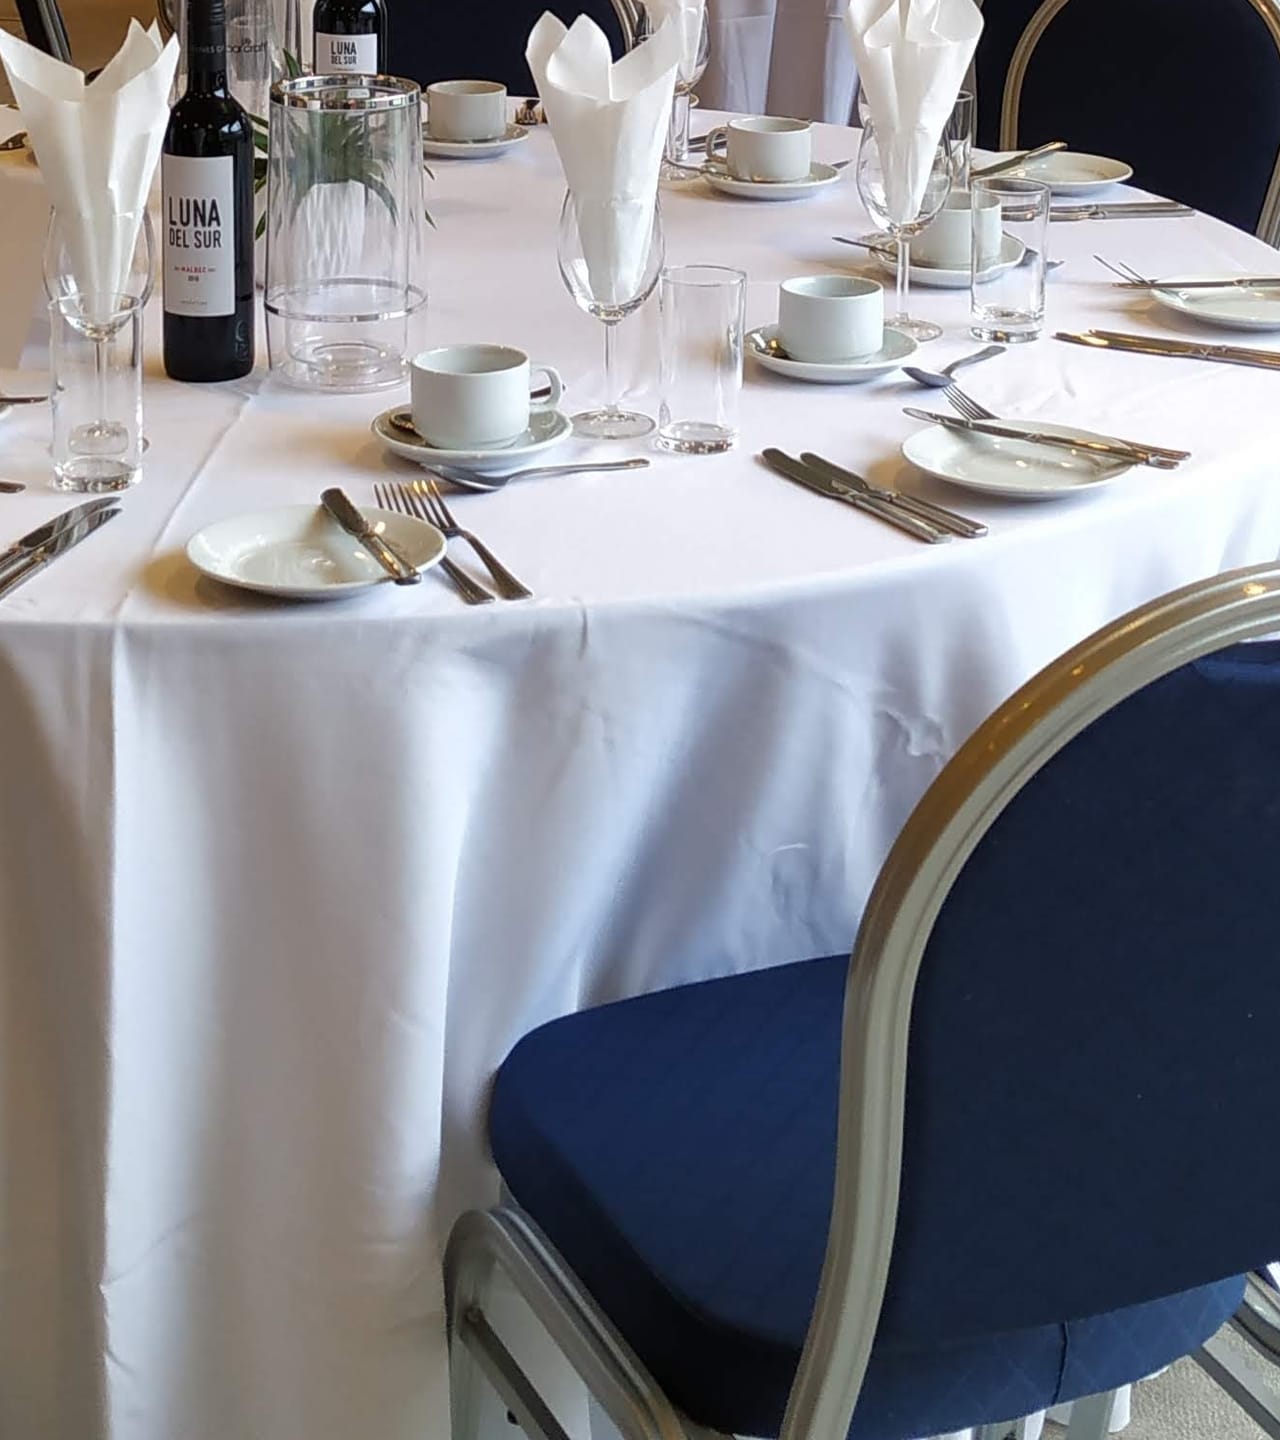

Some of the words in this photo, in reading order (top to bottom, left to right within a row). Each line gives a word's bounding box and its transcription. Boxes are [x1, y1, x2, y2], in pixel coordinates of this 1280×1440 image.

[331, 41, 357, 56] LUNA
[331, 55, 342, 65] DEL
[344, 55, 357, 65] SUR
[169, 196, 221, 228] LUNA
[169, 227, 190, 248] DEL
[194, 230, 222, 249] SUR
